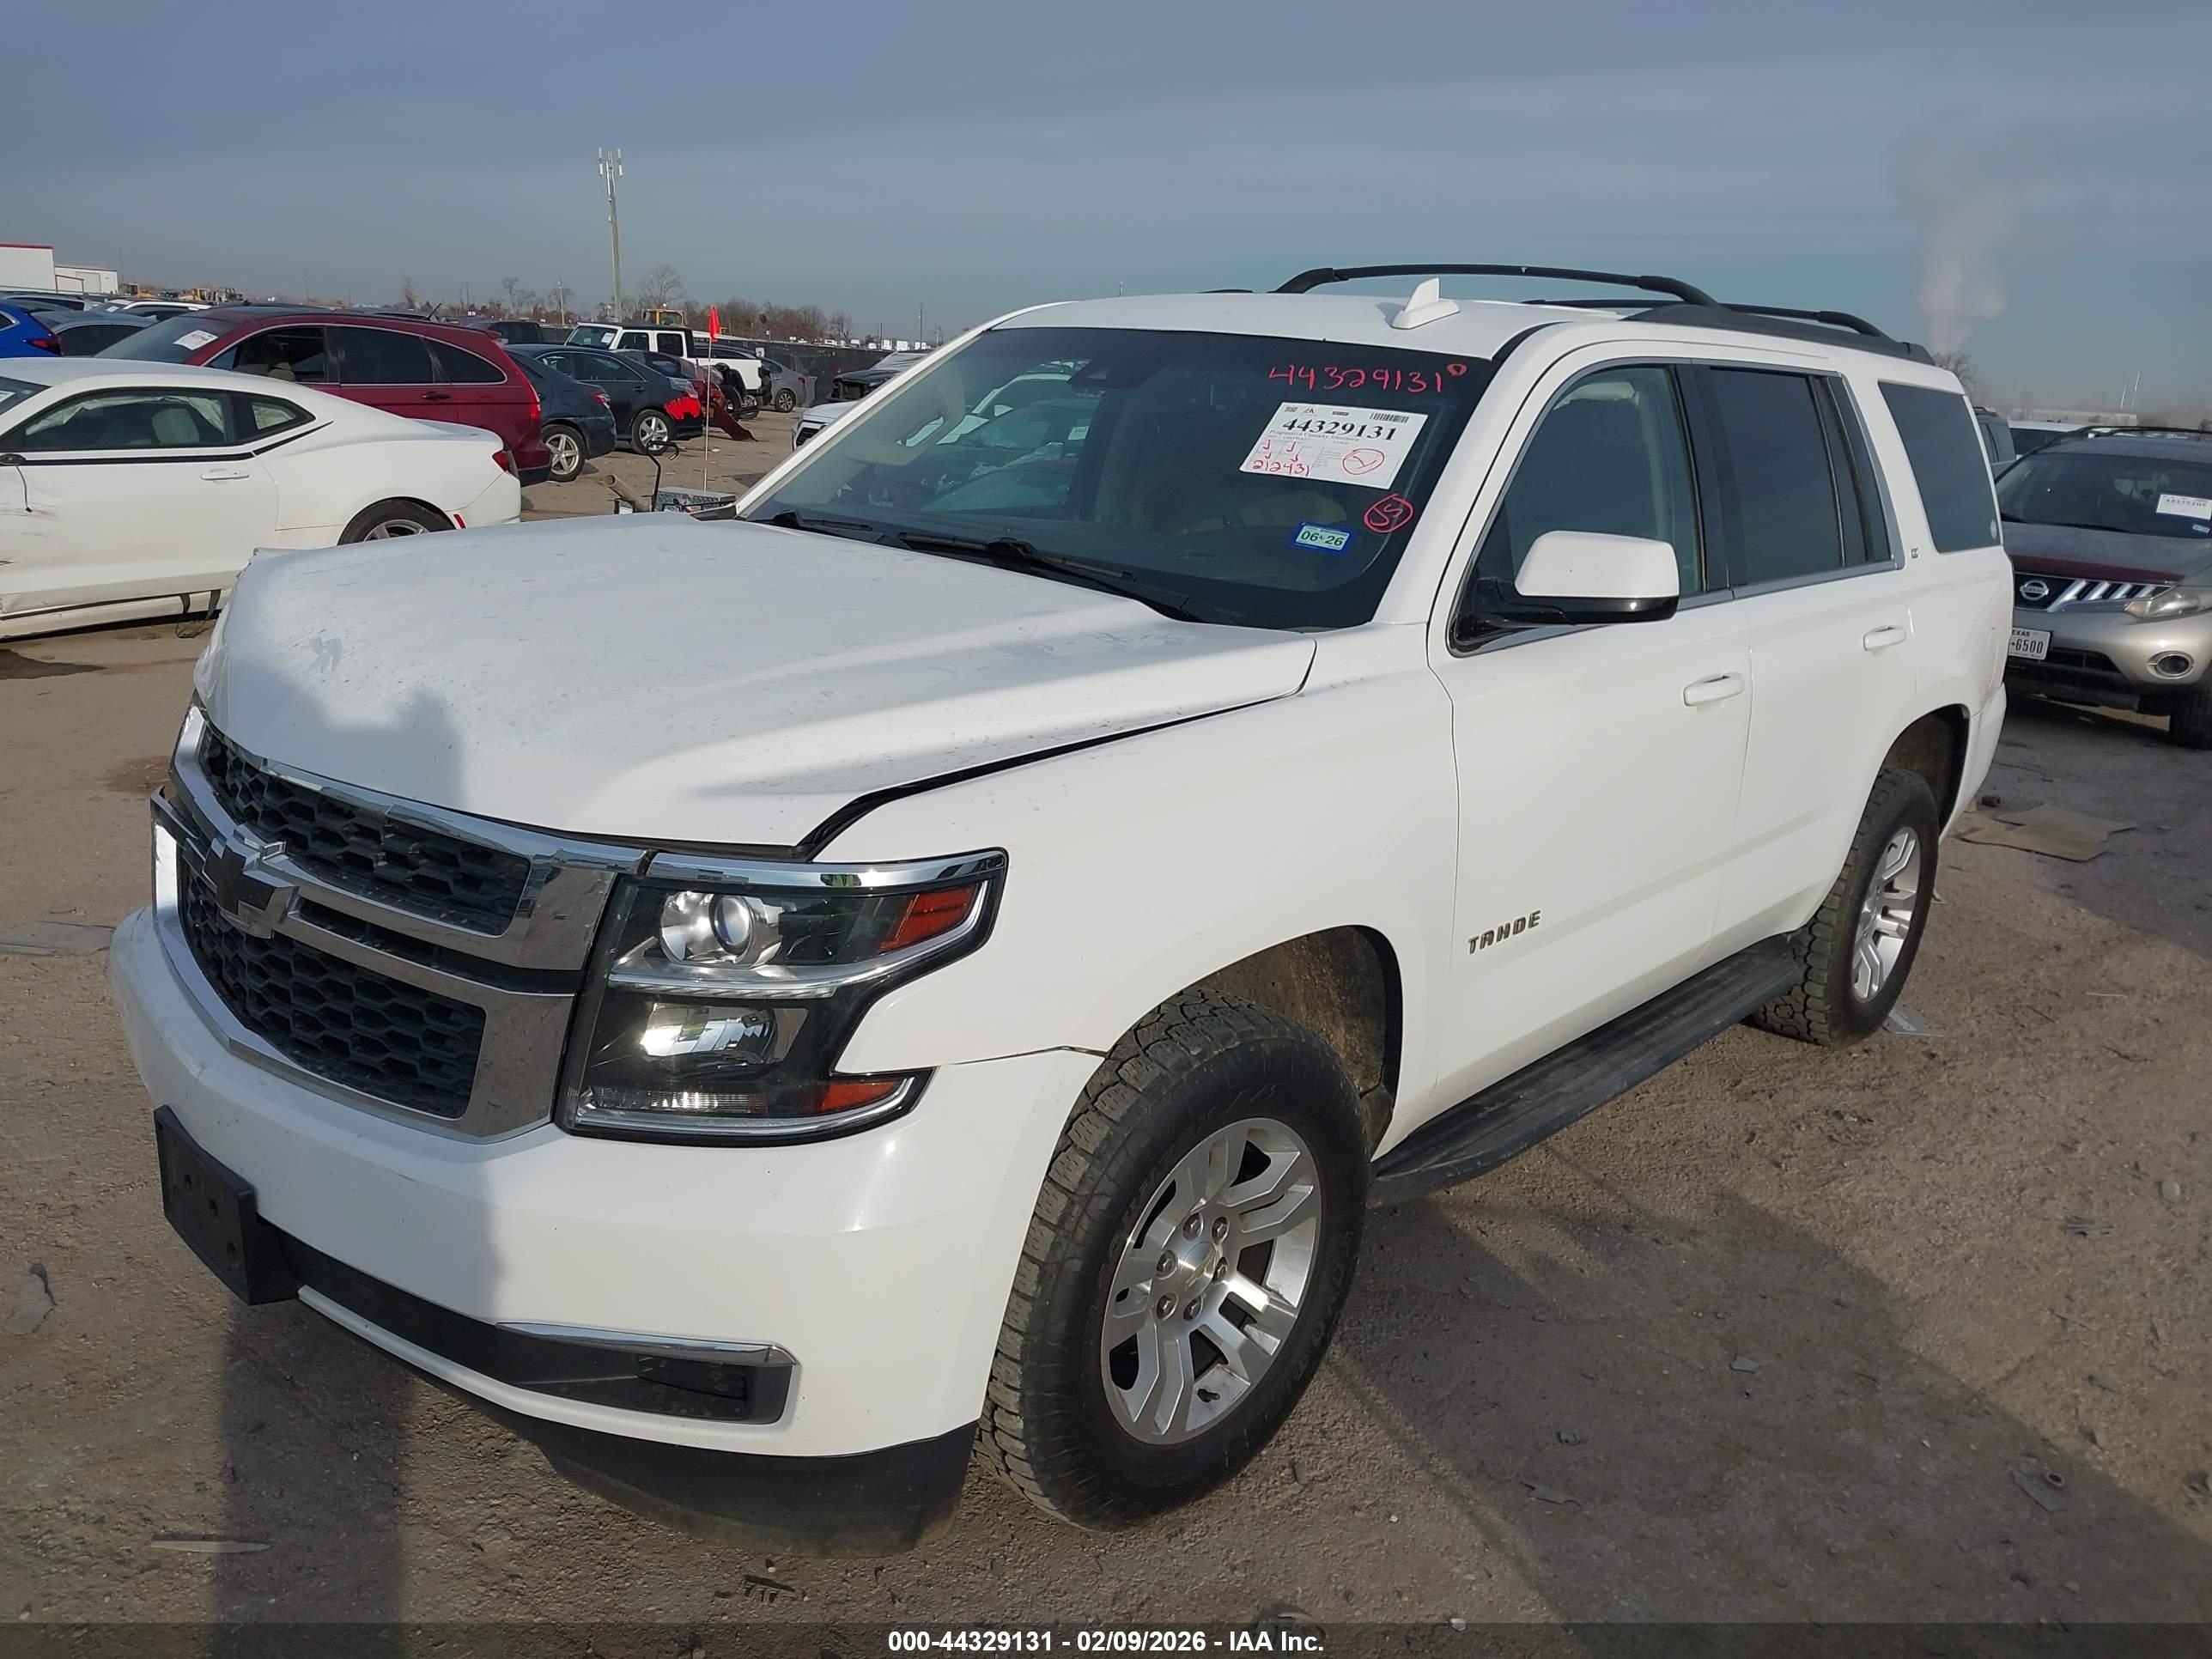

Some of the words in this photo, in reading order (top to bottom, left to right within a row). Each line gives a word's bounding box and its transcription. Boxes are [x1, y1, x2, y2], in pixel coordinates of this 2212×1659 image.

[1268, 363, 1443, 393] 44329131
[1282, 417, 1397, 441] 44329131
[1301, 531, 1320, 542] 06
[1324, 535, 1345, 546] 26
[1468, 909, 1541, 955] TAHOE
